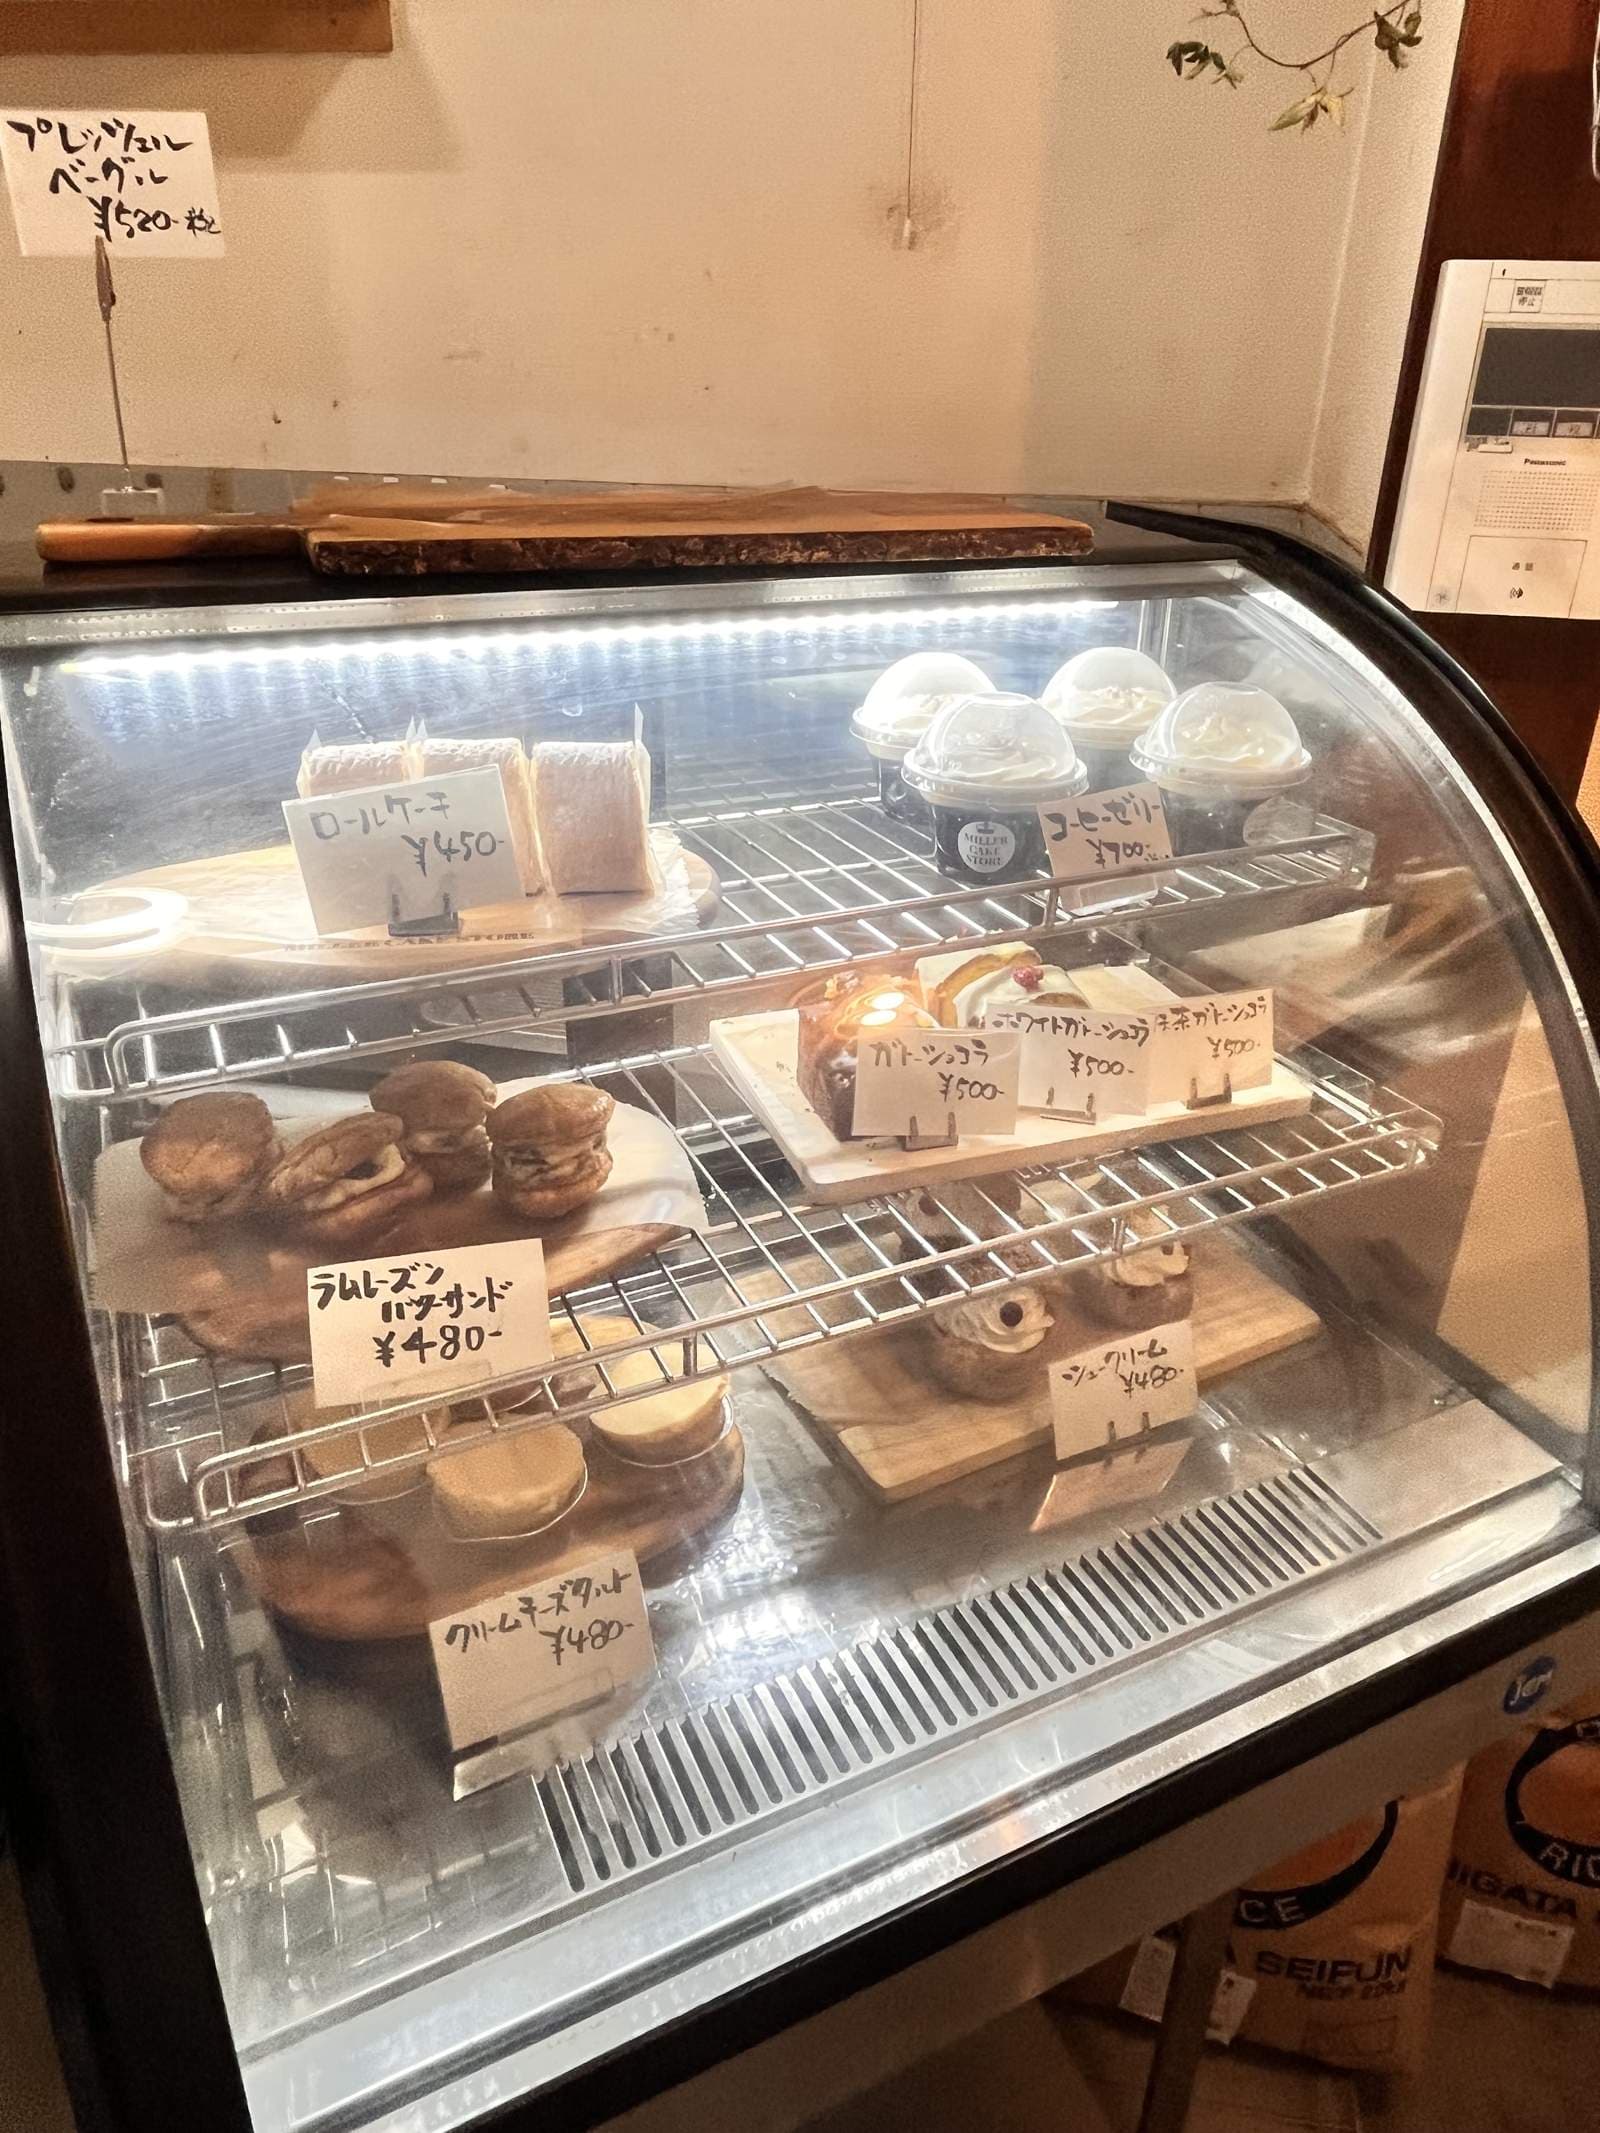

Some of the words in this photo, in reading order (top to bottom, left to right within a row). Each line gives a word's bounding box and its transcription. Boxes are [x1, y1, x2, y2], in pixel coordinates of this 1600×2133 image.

[49, 156, 169, 194] ベーグル
[309, 791, 450, 840] ロールケーキ
[1044, 791, 1161, 842] コーヒーゼリー
[869, 1038, 989, 1068] ガトーショコラ
[310, 1261, 445, 1311] ラムレーズン
[1061, 1338, 1168, 1388] シュークリーム
[445, 1567, 633, 1653] クリームチーズタルト
[1255, 1944, 1412, 1984] SEIFUN
